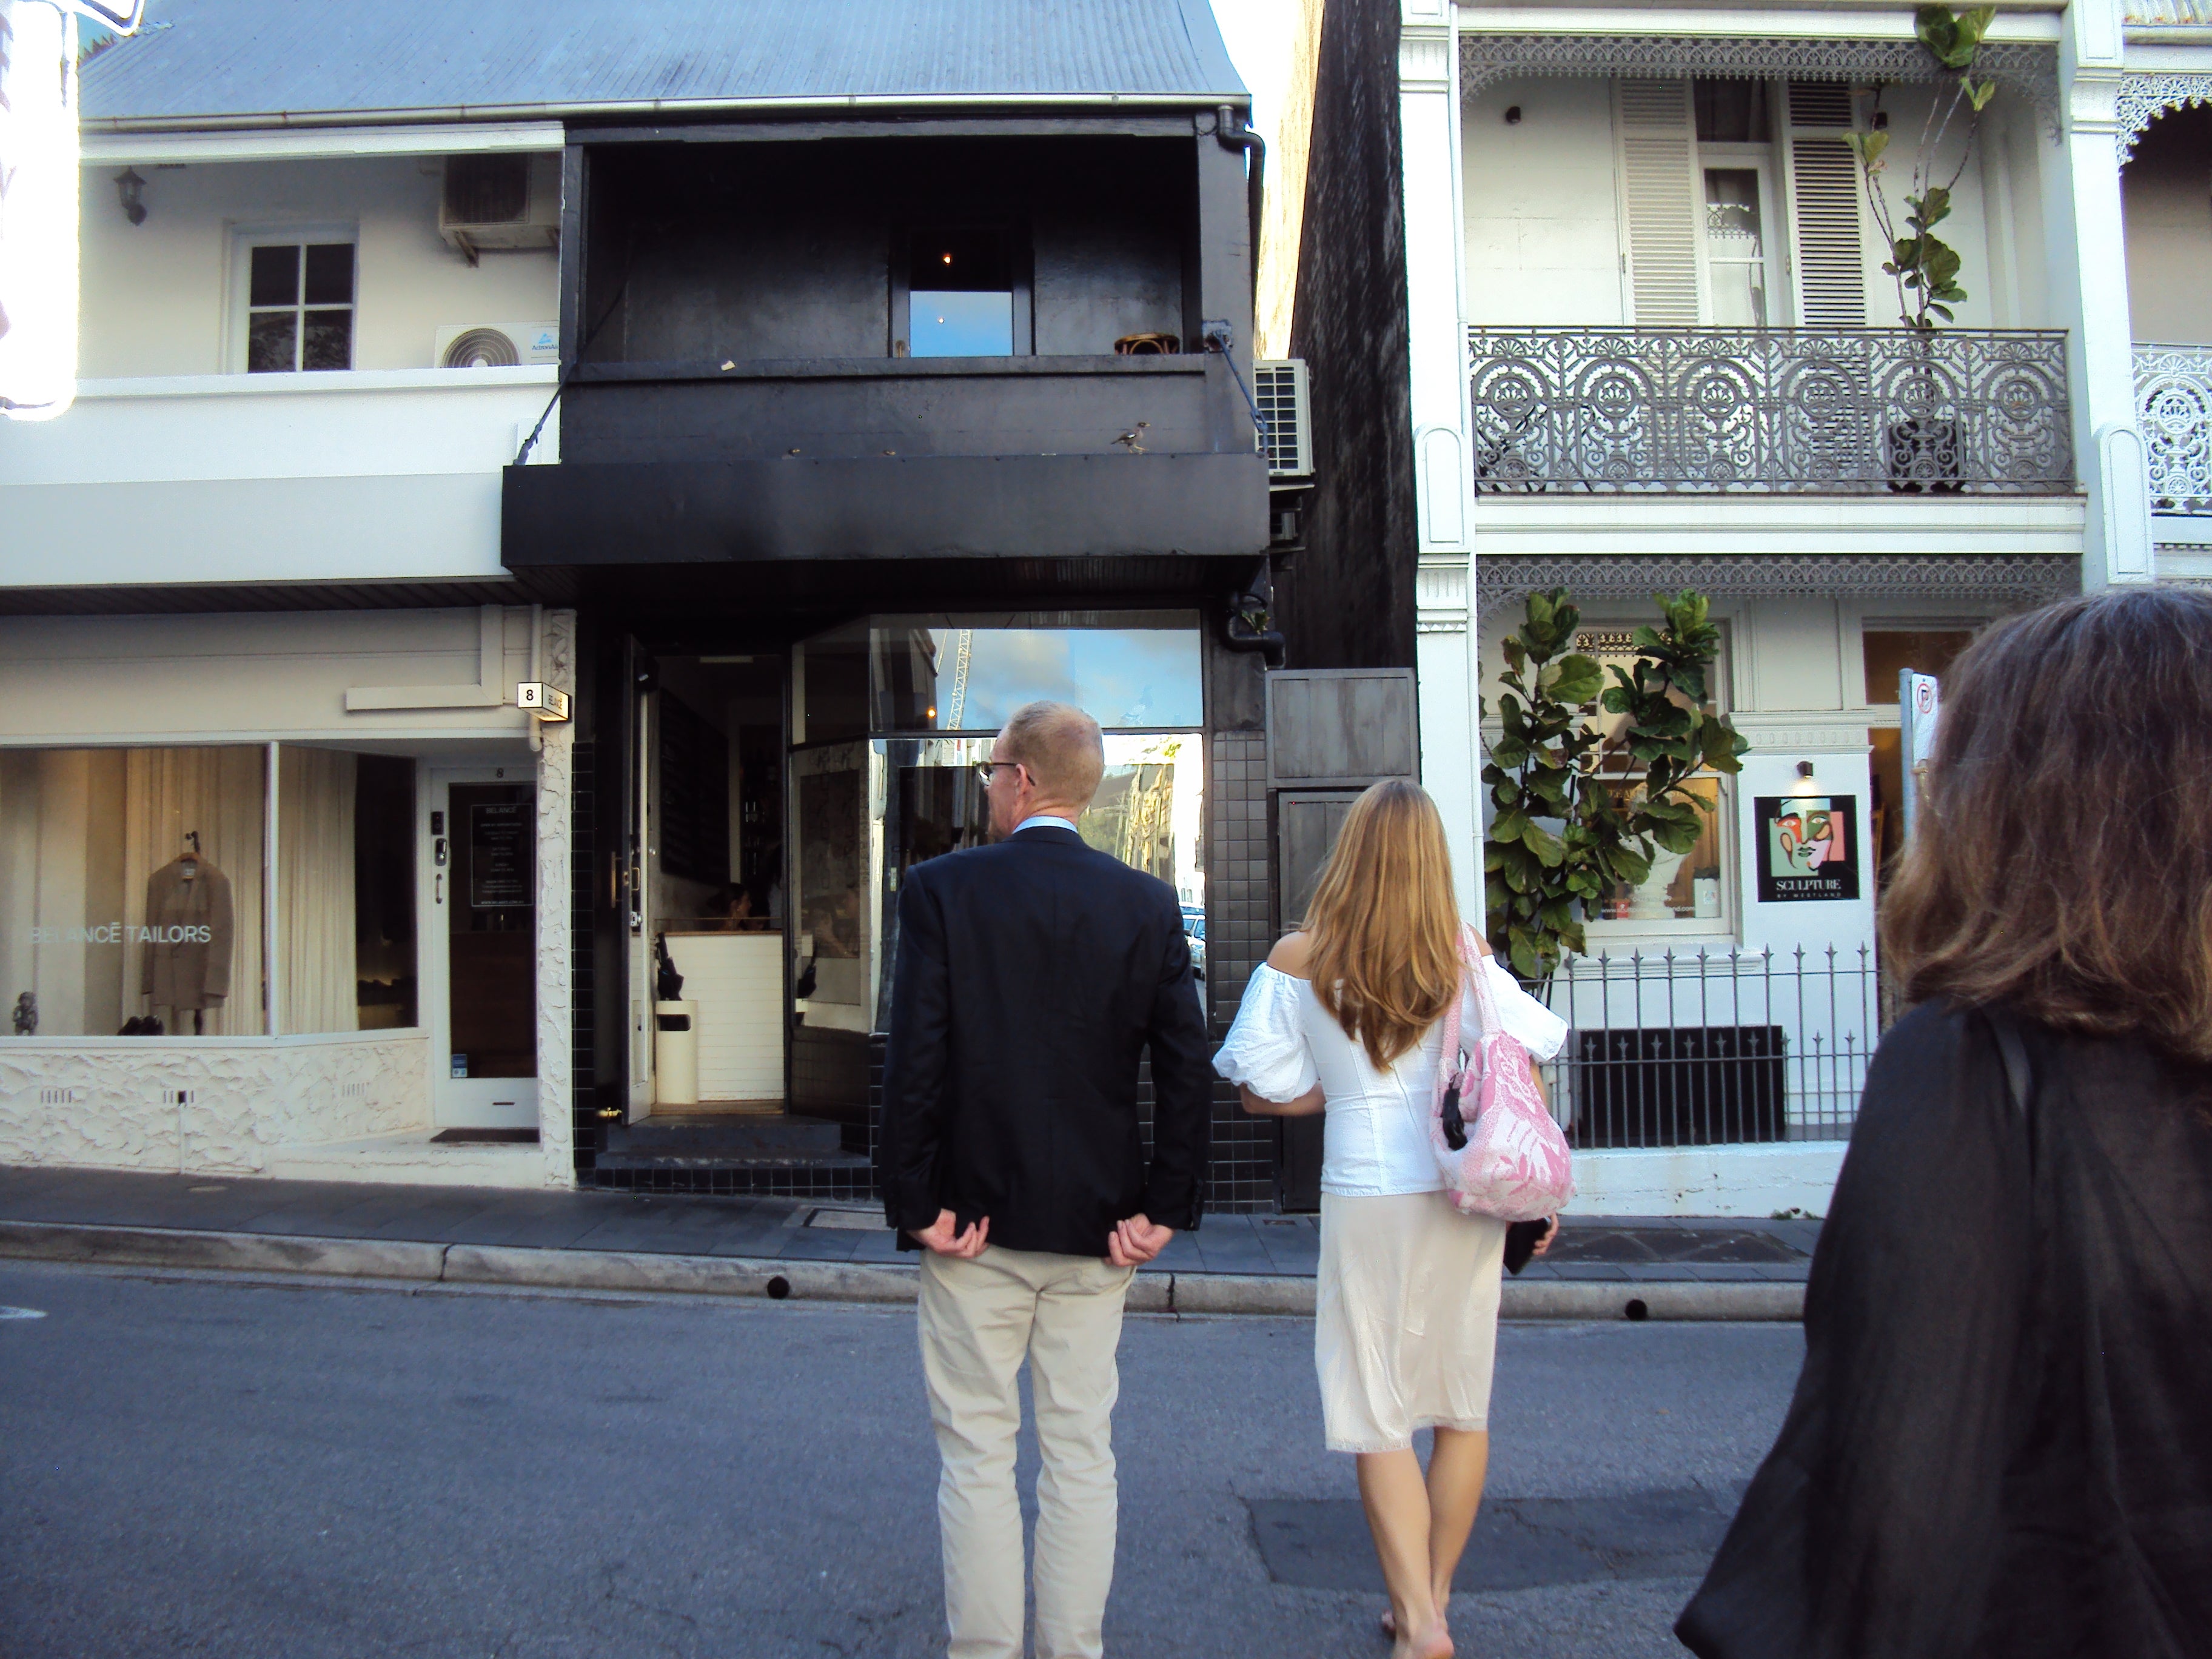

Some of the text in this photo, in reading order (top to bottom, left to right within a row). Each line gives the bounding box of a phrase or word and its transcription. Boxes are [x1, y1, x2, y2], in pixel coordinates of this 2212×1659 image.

[526, 689, 534, 701] 8
[497, 768, 504, 778] 8
[1776, 879, 1842, 891] SCULPTURE
[125, 925, 212, 943] TAILORS
